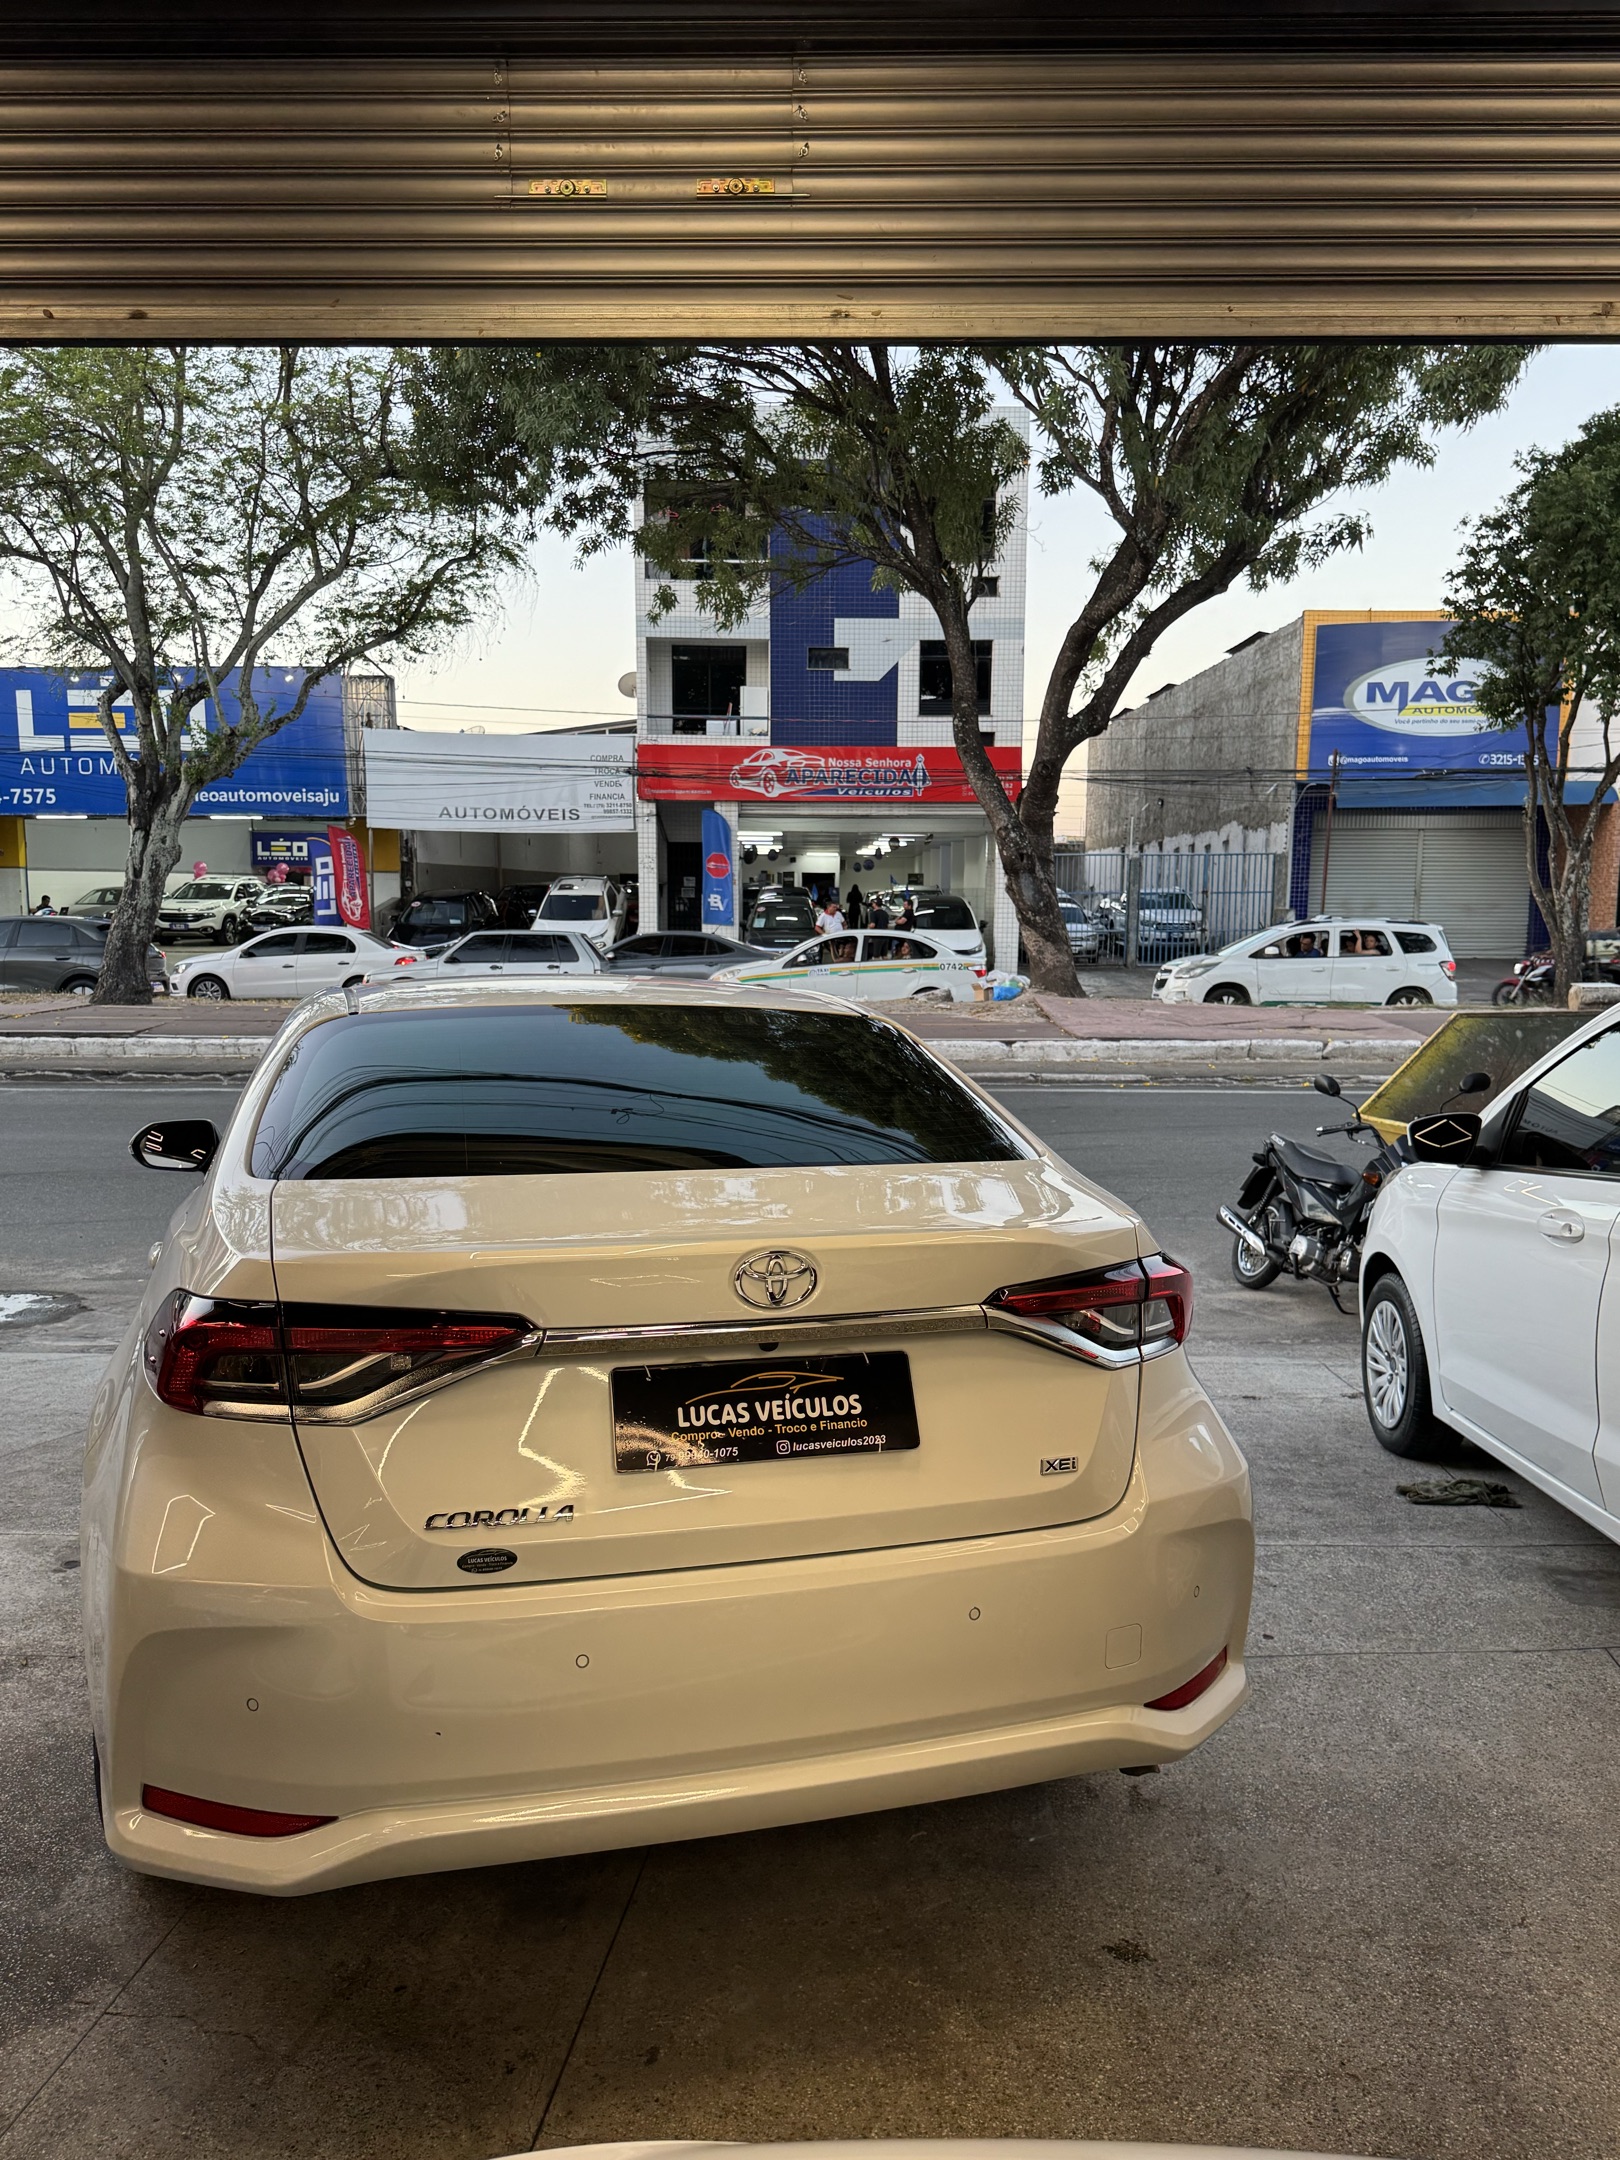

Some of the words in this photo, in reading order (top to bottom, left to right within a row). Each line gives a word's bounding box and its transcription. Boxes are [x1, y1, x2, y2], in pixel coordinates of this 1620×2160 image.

[1366, 681, 1480, 715] MAG
[828, 758, 862, 768] Nossa
[865, 757, 912, 768] Senhora
[594, 767, 620, 776] TROCA
[785, 768, 913, 786] APARECIDA
[594, 780, 620, 788] VENDE
[837, 787, 912, 796] Veículos
[0, 788, 56, 804] -7575
[589, 793, 625, 801] FINANCIA
[439, 805, 580, 821] AUTOMÓVEIS
[677, 1402, 750, 1427] LUCAS
[755, 1393, 862, 1422] VEÍCULOS
[728, 1427, 765, 1438] Vendo
[775, 1423, 807, 1434] Troco
[820, 1418, 868, 1431] Financio
[423, 1504, 575, 1531] COROLLA
